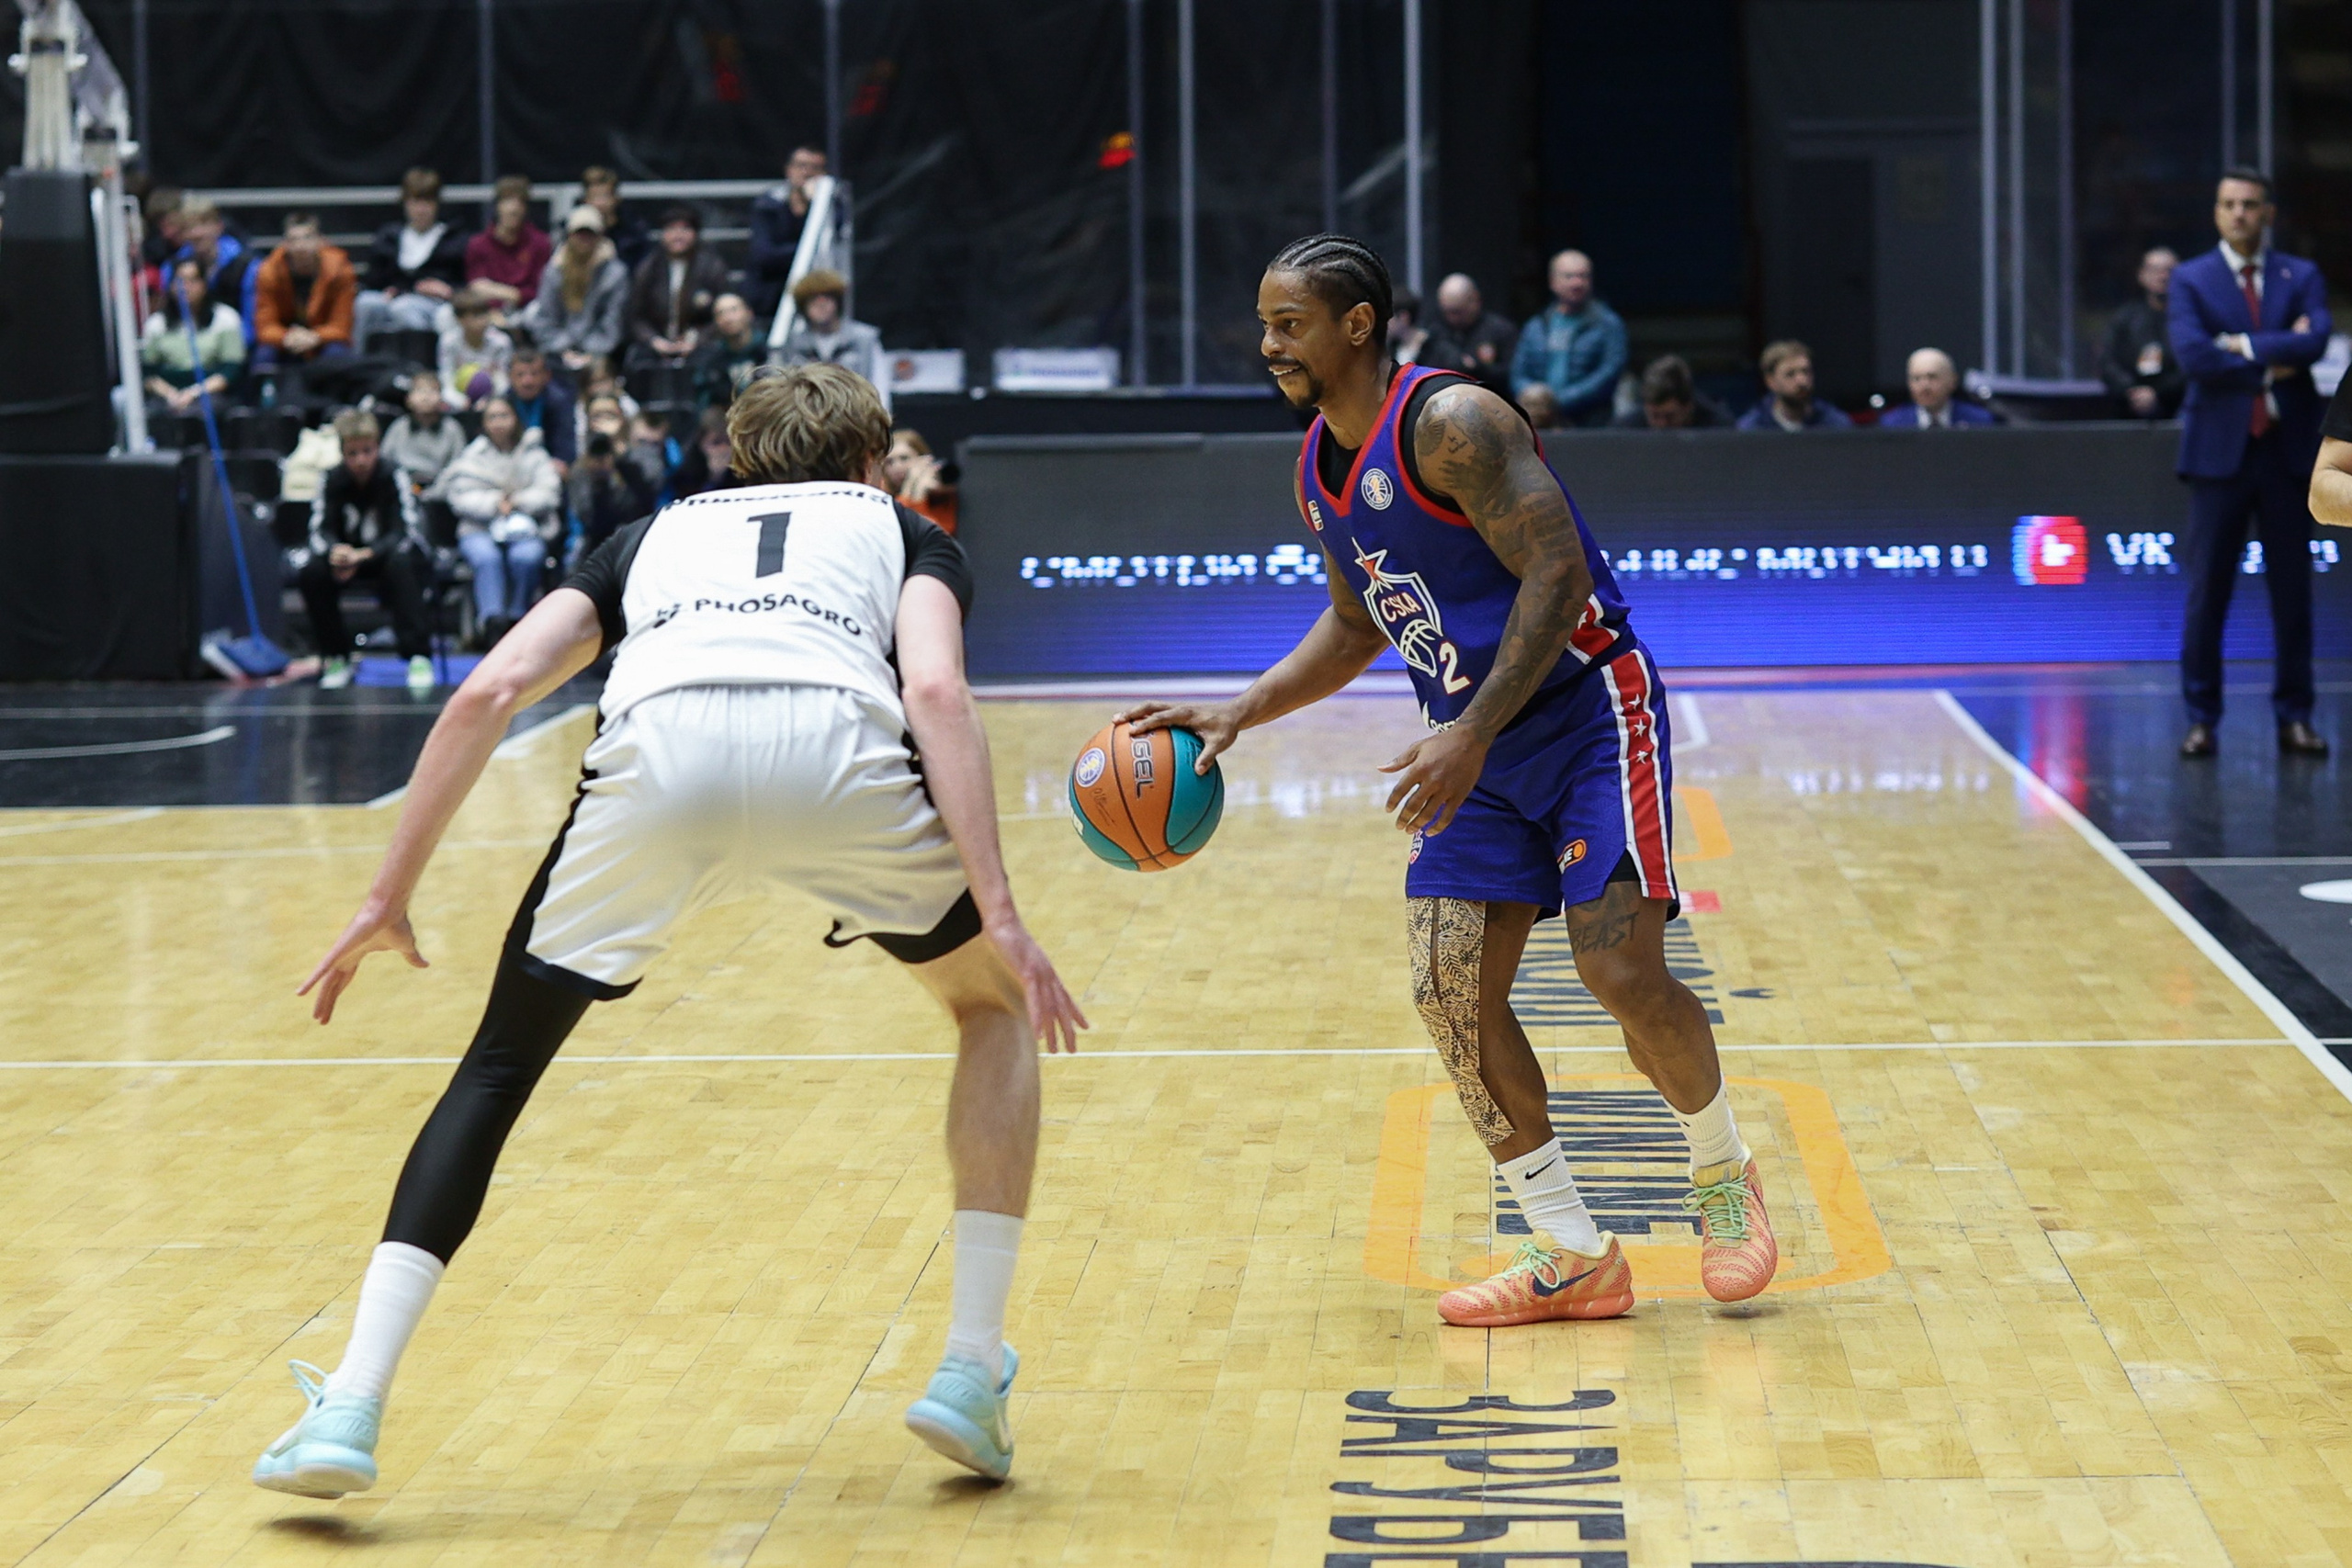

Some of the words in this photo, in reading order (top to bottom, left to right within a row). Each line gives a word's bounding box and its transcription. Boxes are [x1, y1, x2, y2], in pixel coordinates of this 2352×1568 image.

[746, 511, 792, 580] 1
[695, 593, 862, 637] PHOSAGRO
[1380, 592, 1422, 623] CSKA
[1439, 641, 1472, 694] 2
